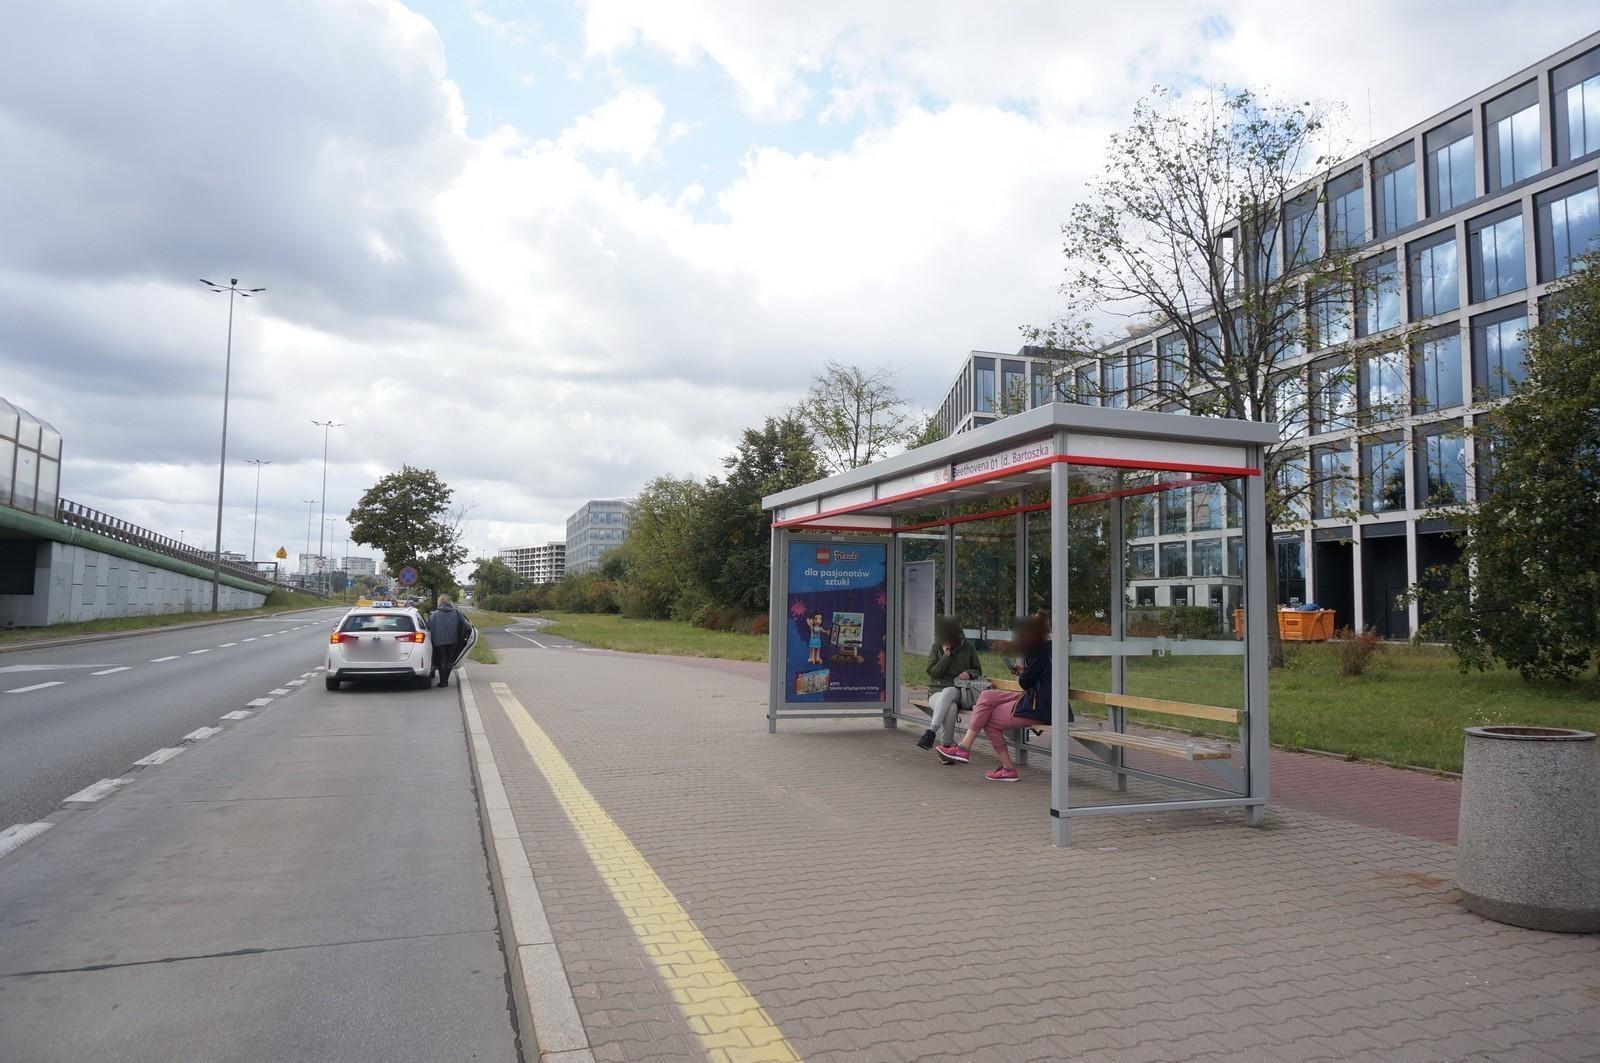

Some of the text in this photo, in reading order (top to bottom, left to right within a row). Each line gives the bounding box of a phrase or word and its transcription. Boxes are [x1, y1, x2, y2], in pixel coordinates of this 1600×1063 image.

[990, 459, 998, 470] 01
[1013, 445, 1049, 463] Bartoszka
[804, 567, 870, 578] dla pasjonatów
[825, 578, 850, 586] sztuki
